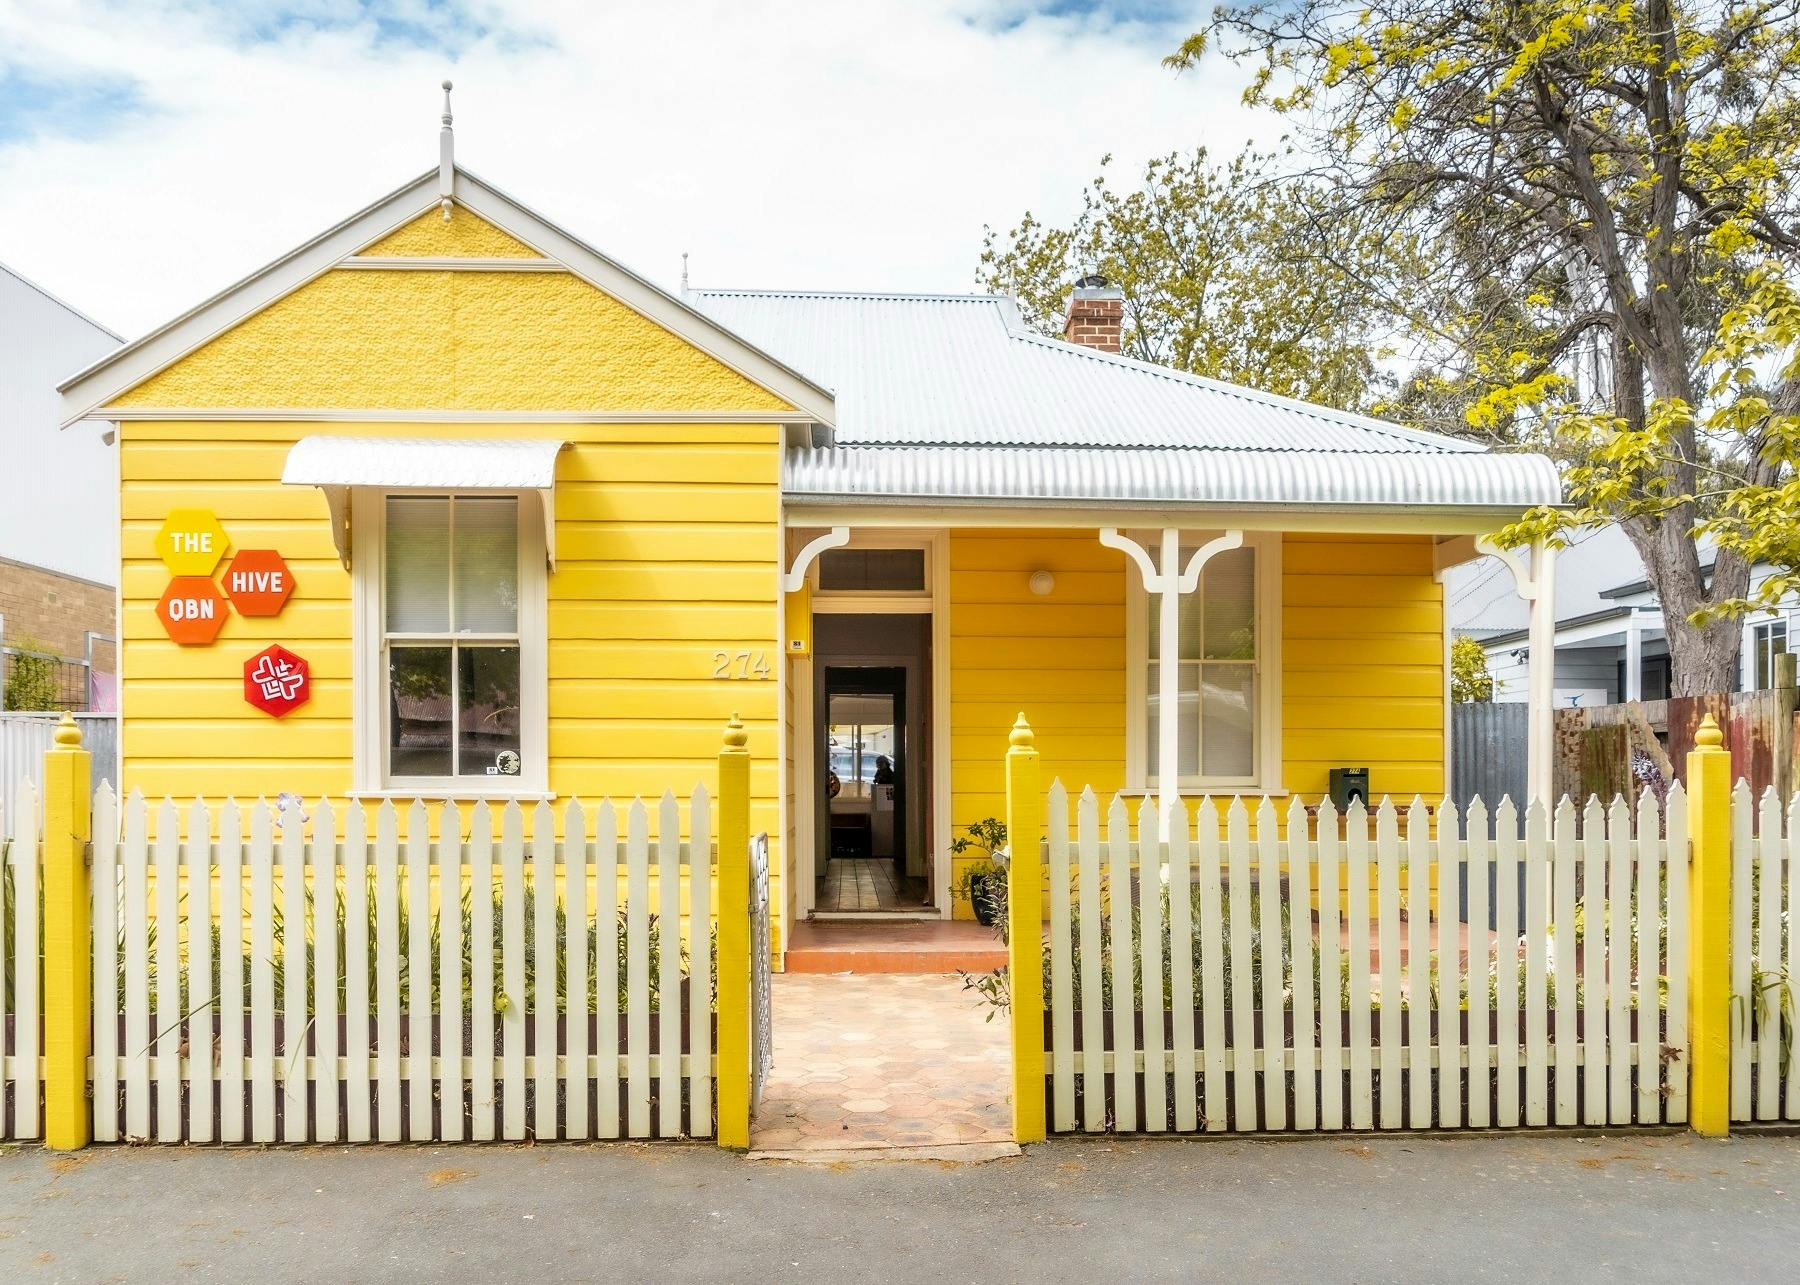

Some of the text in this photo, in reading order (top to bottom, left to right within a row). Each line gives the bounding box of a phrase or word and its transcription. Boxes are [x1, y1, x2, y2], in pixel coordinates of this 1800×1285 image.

[170, 532, 213, 553] THE
[232, 572, 283, 593] HIVE
[169, 598, 215, 622] QBN
[713, 649, 771, 680] 274
